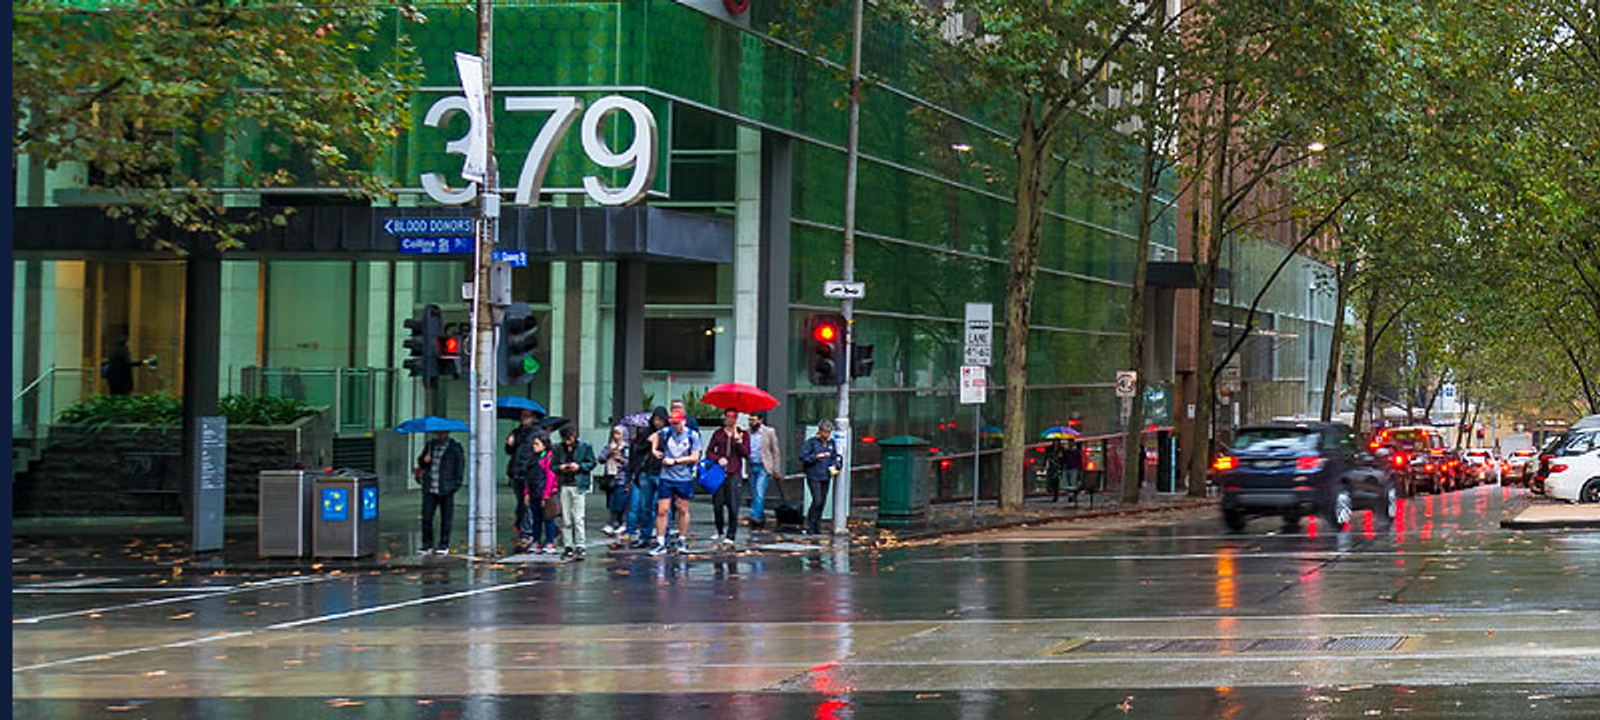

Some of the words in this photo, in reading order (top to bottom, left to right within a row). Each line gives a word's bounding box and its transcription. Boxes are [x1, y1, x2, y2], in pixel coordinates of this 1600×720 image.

[420, 94, 658, 206] 379
[394, 219, 428, 231] BLOOD
[430, 219, 471, 232] DONORS
[402, 237, 436, 249] Collins
